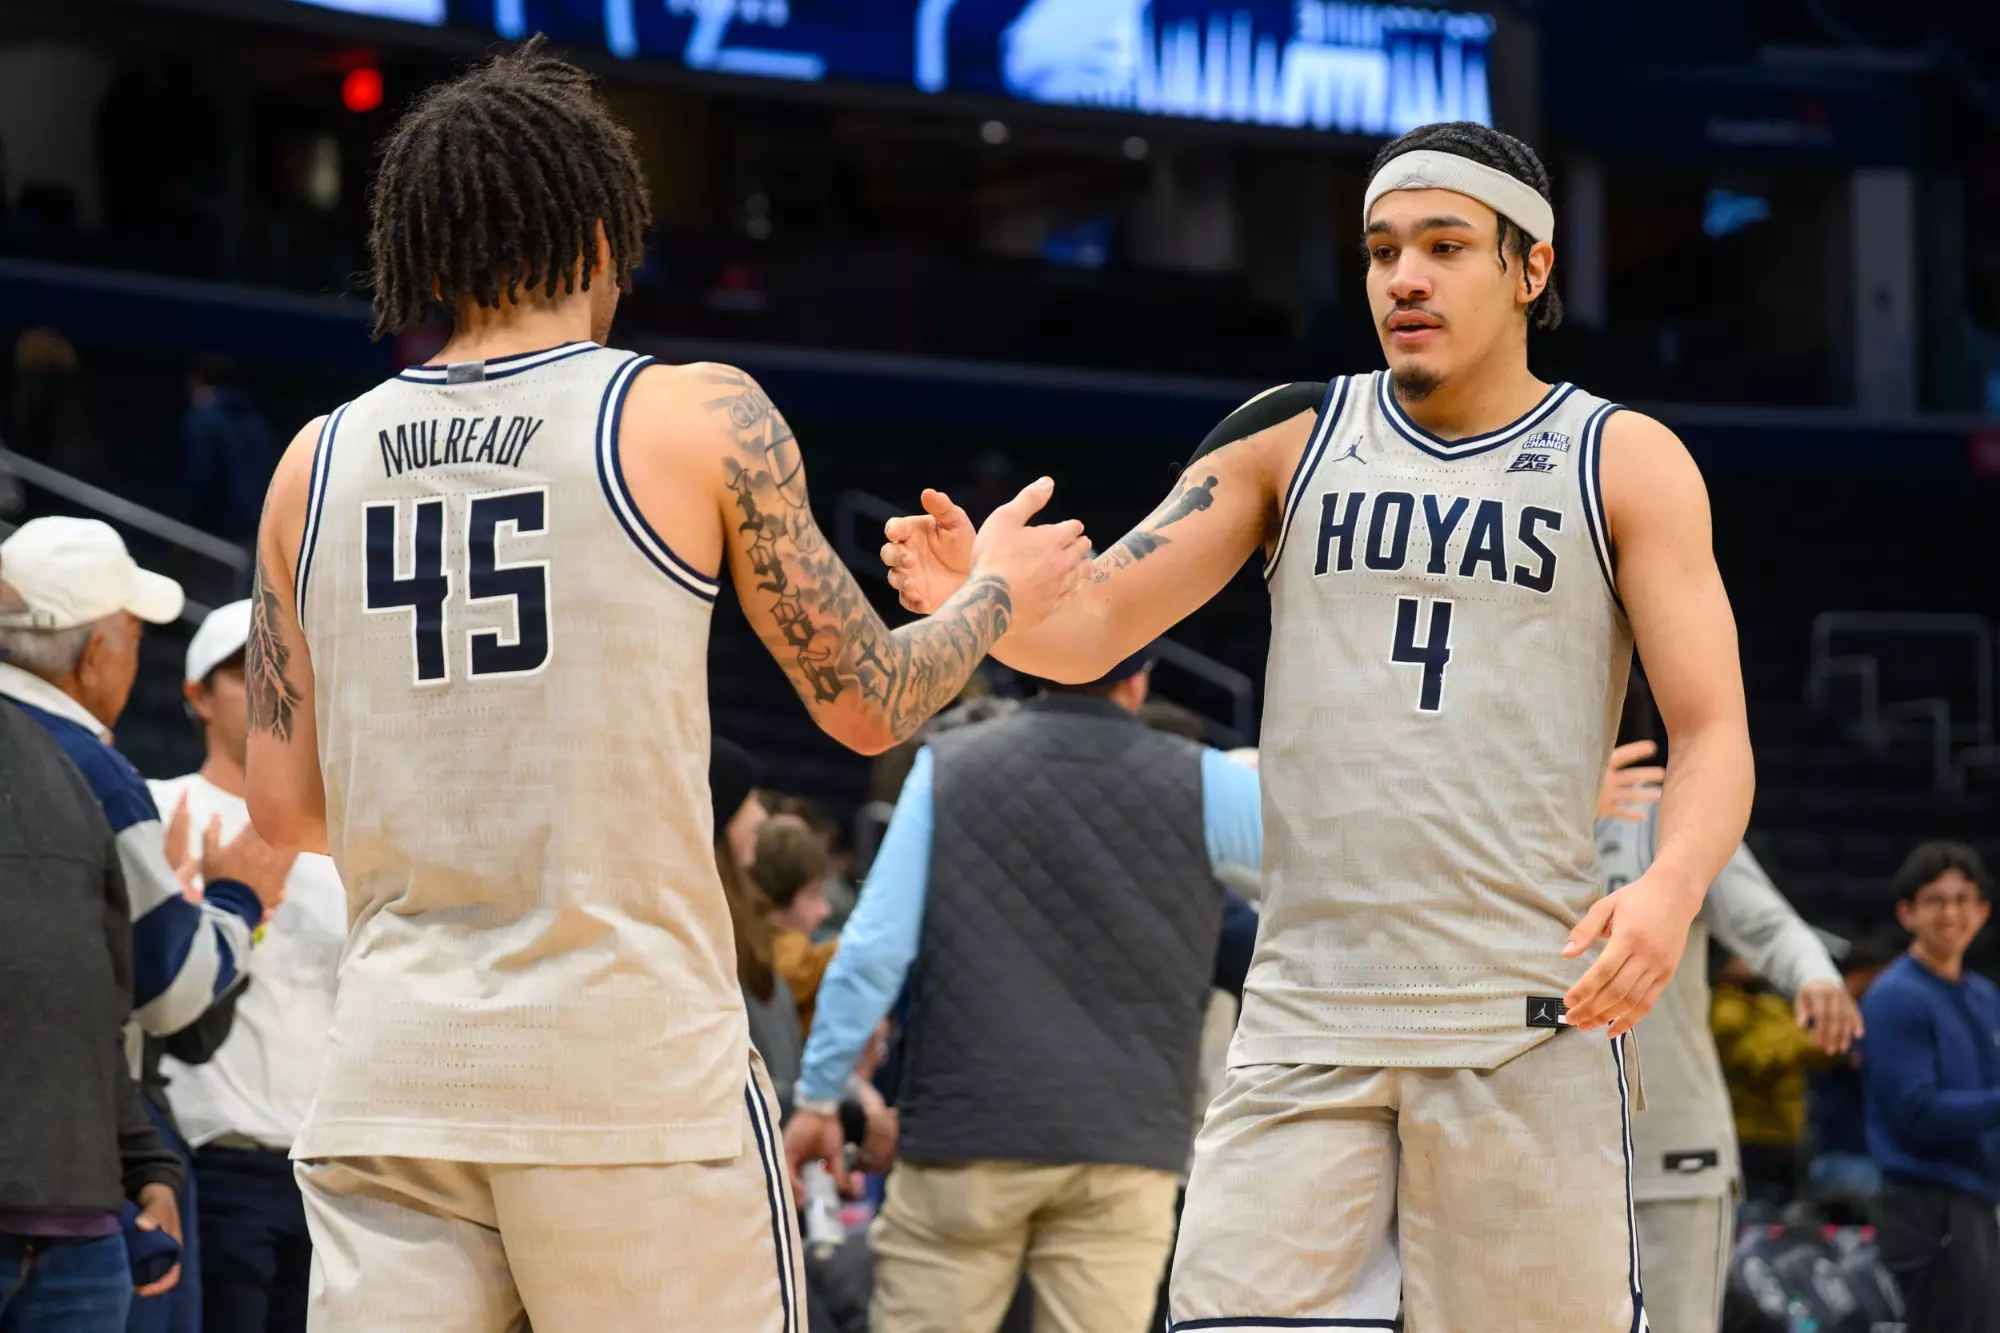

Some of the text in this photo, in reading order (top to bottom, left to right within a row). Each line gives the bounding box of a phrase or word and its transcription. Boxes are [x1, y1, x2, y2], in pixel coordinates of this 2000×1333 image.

[378, 416, 544, 478] MULREADY
[1522, 440, 1571, 452] CHANGE
[1529, 432, 1570, 443] BE THE
[1509, 461, 1558, 471] EAST
[1516, 453, 1551, 462] BIG
[1313, 490, 1563, 595] HOYAS
[361, 484, 554, 687] 45
[1389, 595, 1455, 713] 4
